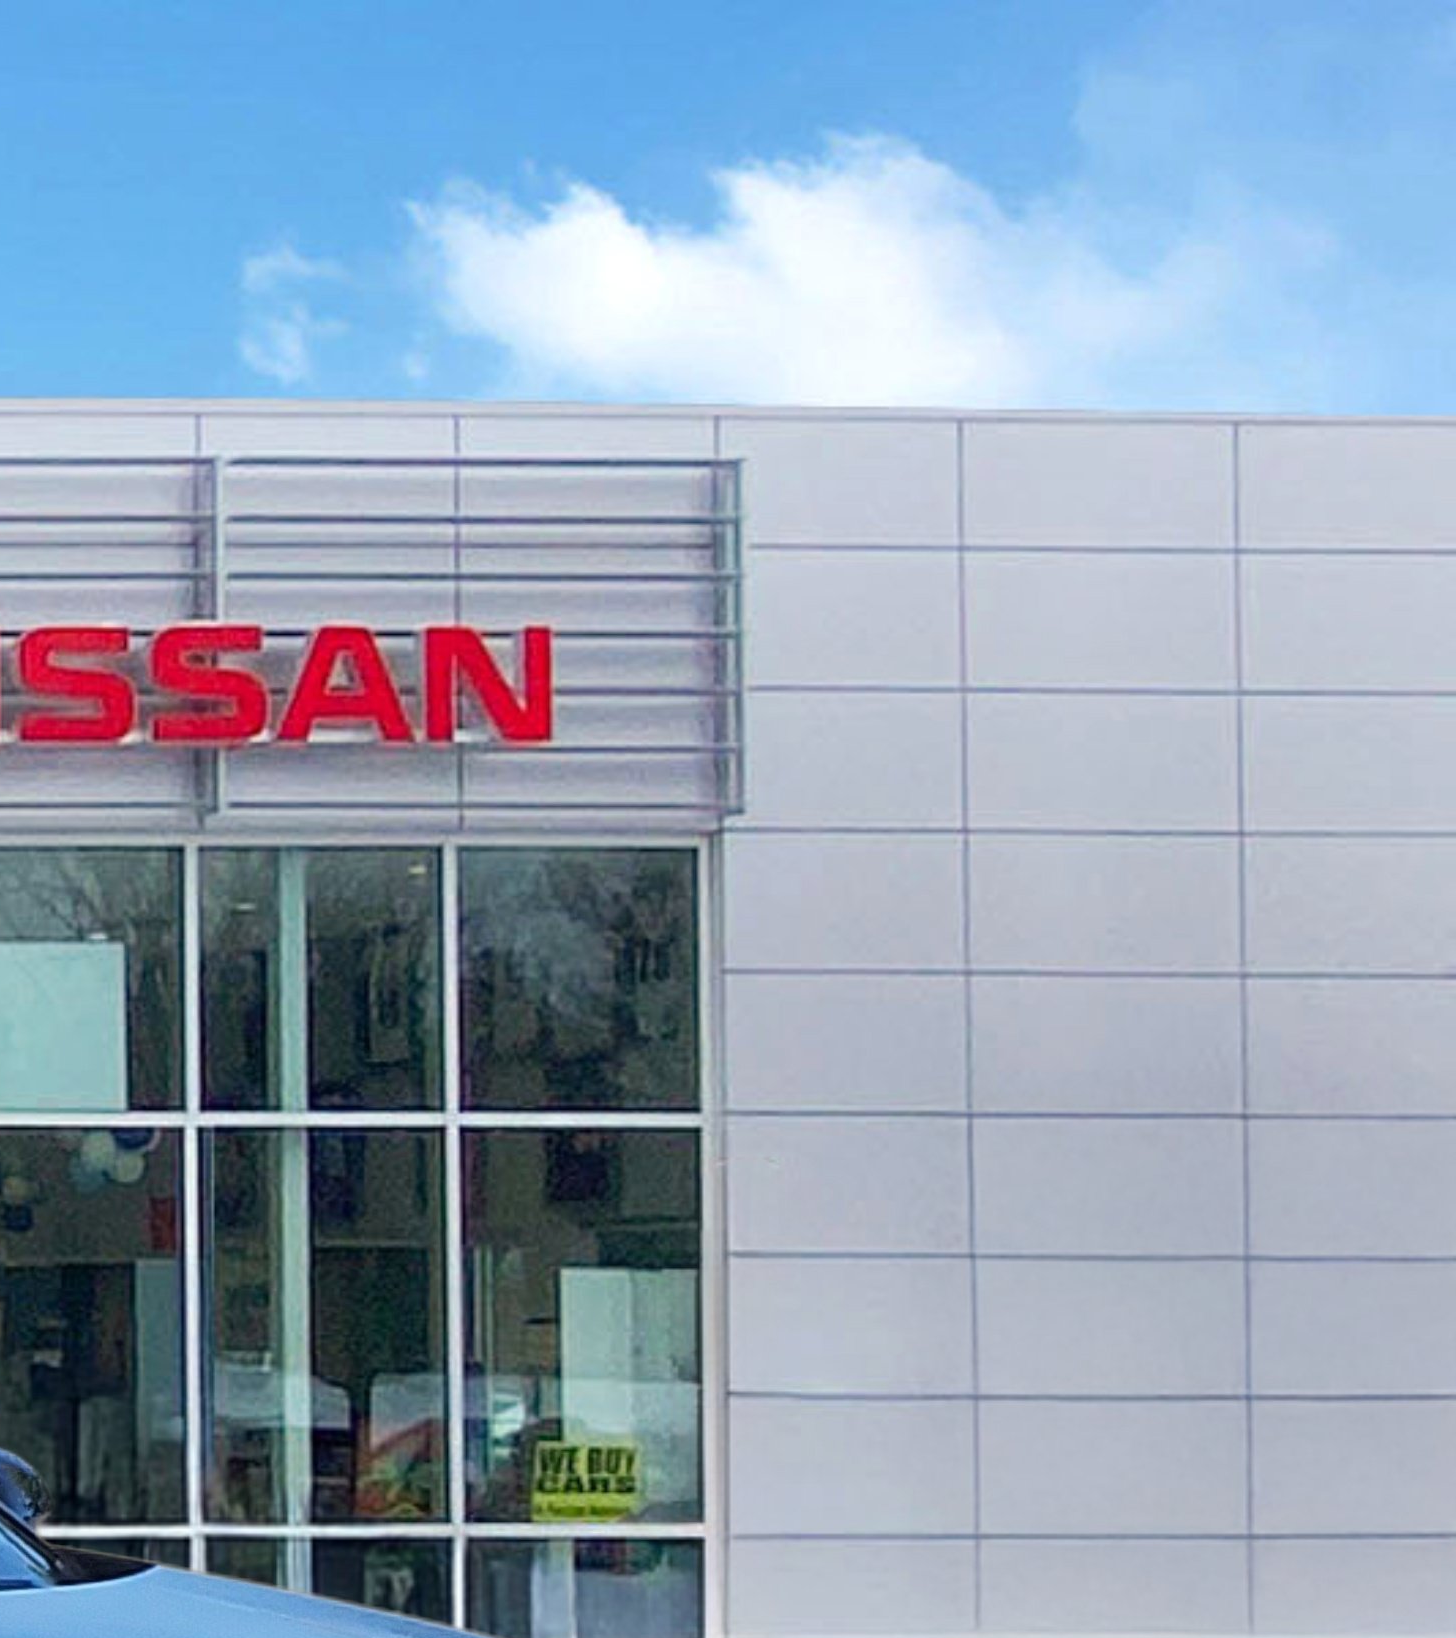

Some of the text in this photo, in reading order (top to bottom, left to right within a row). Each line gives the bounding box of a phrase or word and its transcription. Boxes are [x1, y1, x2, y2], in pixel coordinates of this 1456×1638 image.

[538, 1447, 636, 1474] WE BUY
[536, 1475, 635, 1493] CARS
